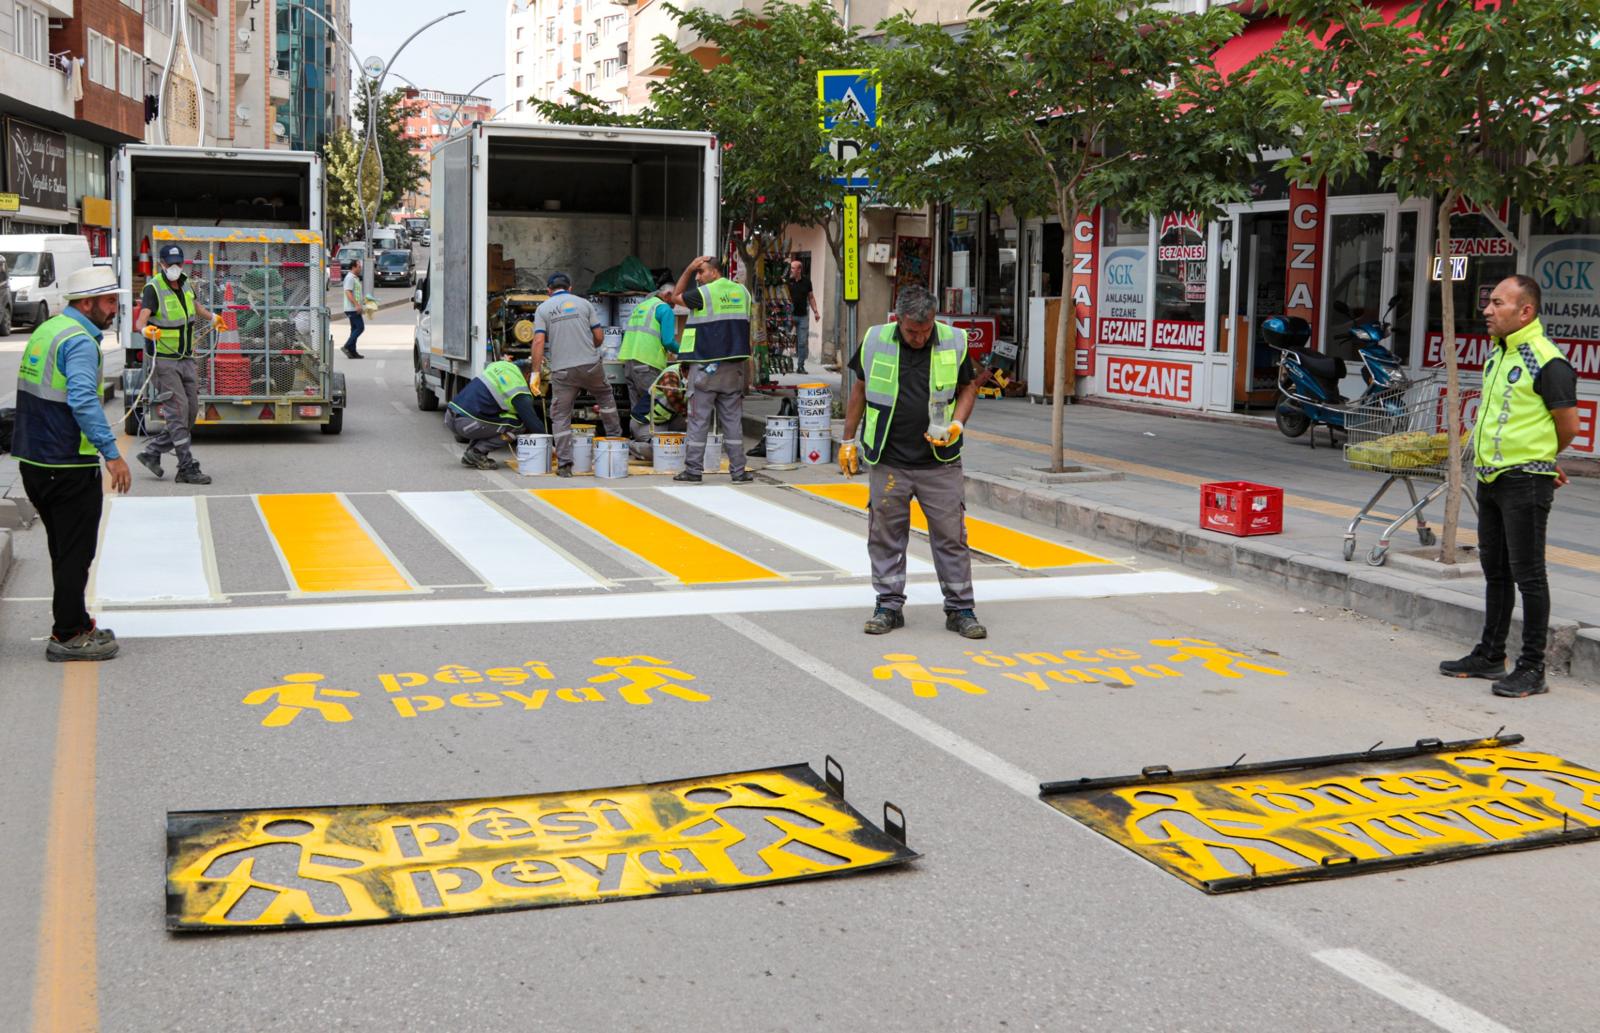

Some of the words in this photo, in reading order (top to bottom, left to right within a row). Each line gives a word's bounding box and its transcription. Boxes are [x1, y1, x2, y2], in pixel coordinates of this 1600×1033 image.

[1107, 263, 1134, 286] SGK
[1541, 260, 1595, 290] SGK
[1072, 220, 1094, 371] CZANE
[1105, 293, 1144, 304] ANLAŞMALI
[1537, 302, 1600, 318] ANLAŞMA
[1111, 307, 1137, 318] ECZANE
[1101, 320, 1146, 343] ECZANE
[1155, 323, 1204, 347] ECZANE
[1546, 324, 1600, 339] ECZANE
[1428, 335, 1494, 365] EZAN
[1109, 362, 1191, 398] ECZANE
[1491, 384, 1513, 463] ZABITA
[963, 648, 1142, 668] önce
[1001, 664, 1184, 692] yaya
[391, 688, 607, 718] peya
[1232, 774, 1462, 813] önce
[1317, 799, 1545, 856] yaya
[409, 848, 708, 908] peya
